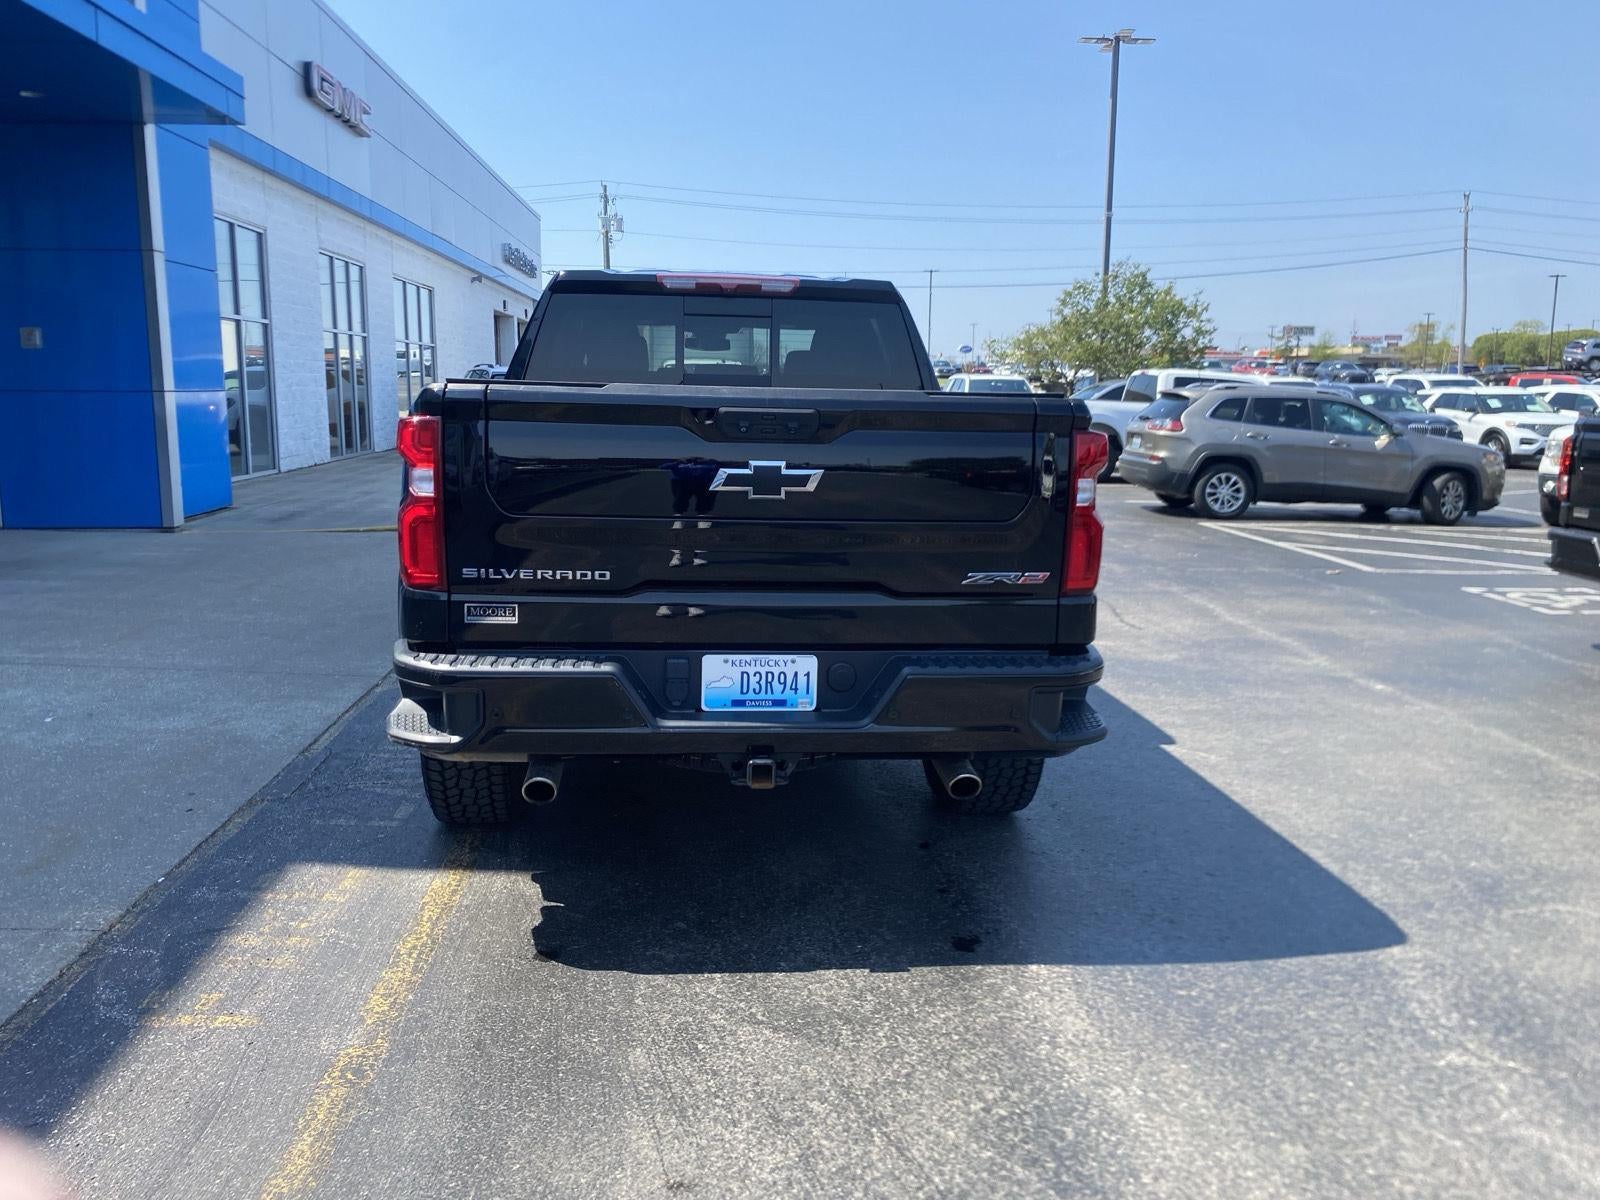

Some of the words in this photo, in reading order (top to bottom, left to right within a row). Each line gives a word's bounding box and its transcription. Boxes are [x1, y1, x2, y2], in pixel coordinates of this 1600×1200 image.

[303, 61, 373, 138] GMC
[462, 568, 611, 580] SILVERADO
[961, 572, 1051, 584] ZR2
[470, 607, 513, 617] MOORE
[731, 659, 789, 667] KENTUCKY
[740, 671, 811, 695] D3R941
